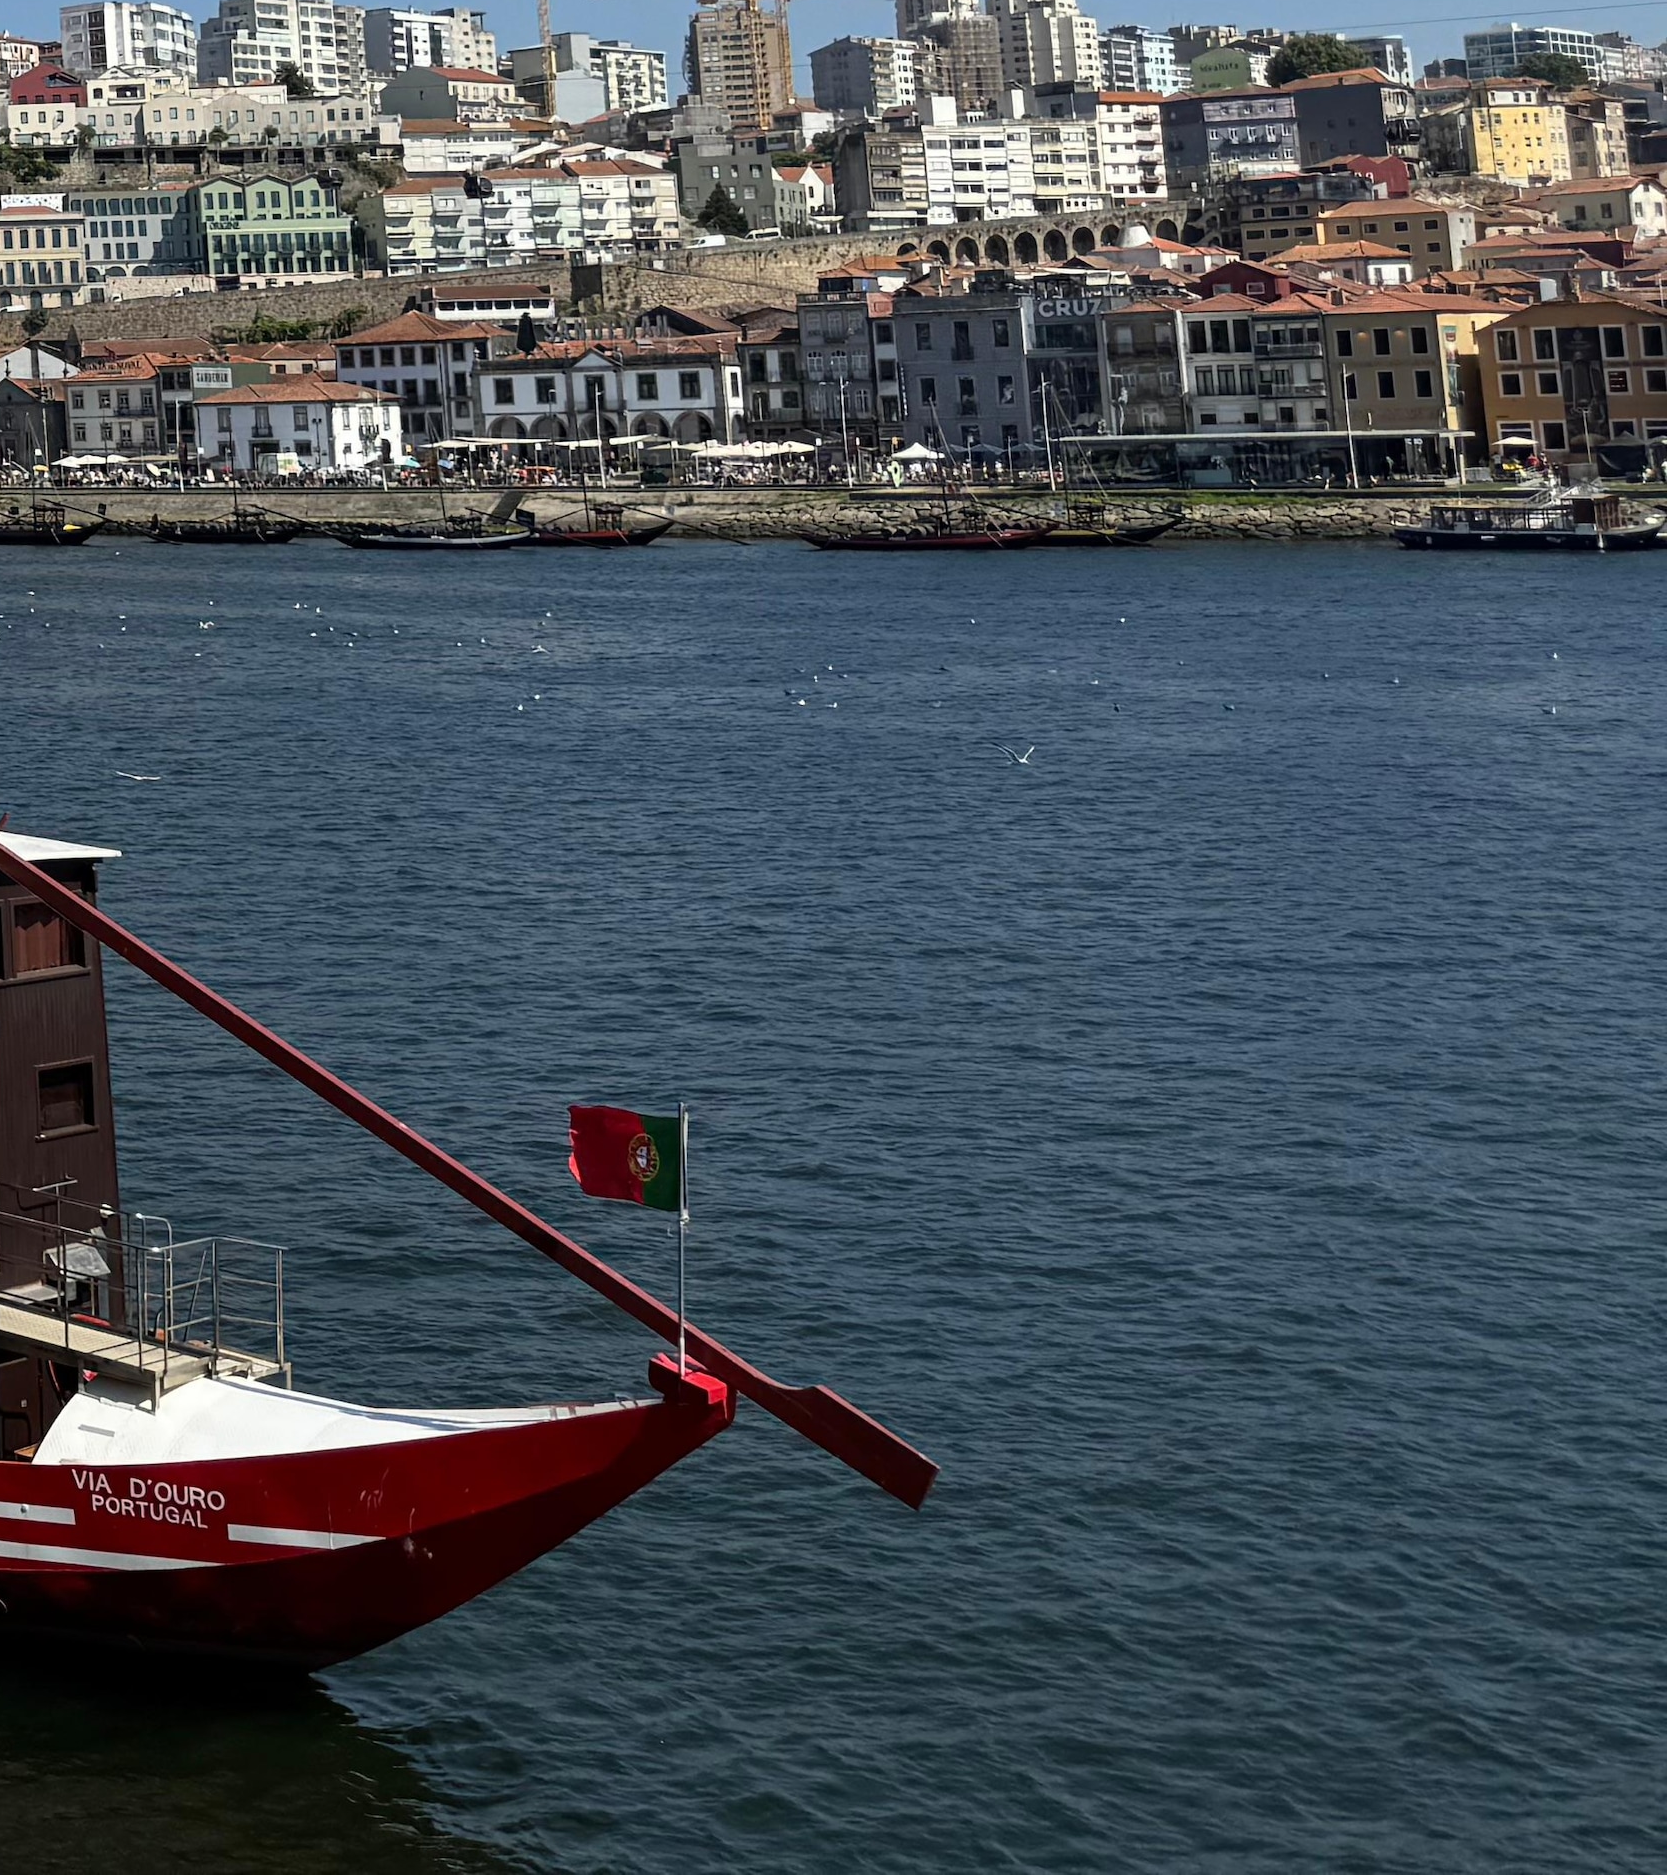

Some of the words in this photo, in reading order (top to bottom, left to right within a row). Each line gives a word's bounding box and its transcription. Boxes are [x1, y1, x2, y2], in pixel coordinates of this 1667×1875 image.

[1038, 299, 1102, 317] CRUZ
[71, 1468, 113, 1495] VIA
[129, 1477, 226, 1511] D'OURO
[91, 1494, 209, 1529] PORTUGAL
